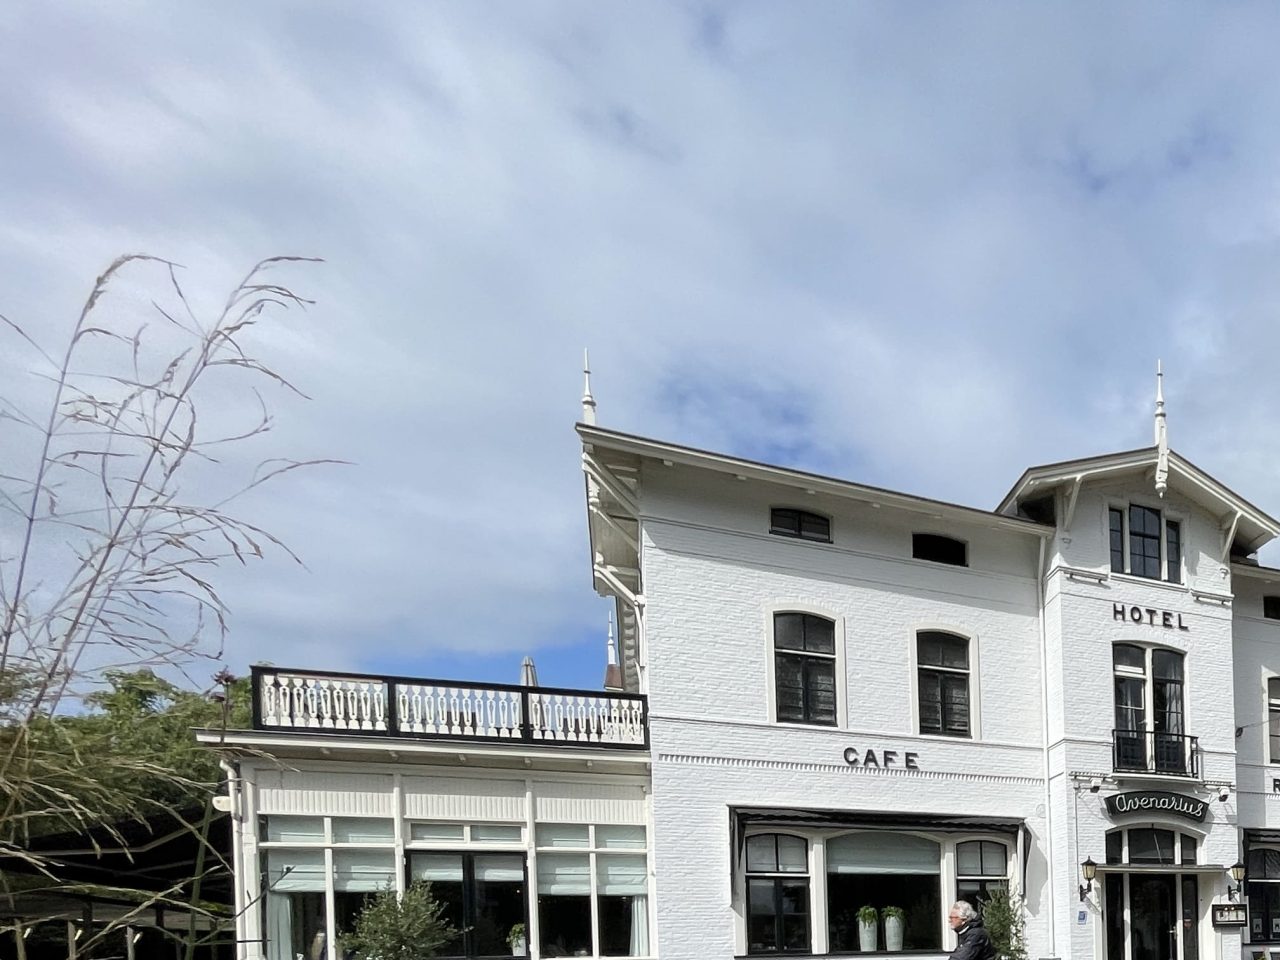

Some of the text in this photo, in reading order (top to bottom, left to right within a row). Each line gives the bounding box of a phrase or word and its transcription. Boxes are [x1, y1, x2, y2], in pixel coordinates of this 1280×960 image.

[1113, 603, 1189, 631] HOTEL
[843, 747, 920, 770] CAFE
[1115, 795, 1204, 817] Avenarius
